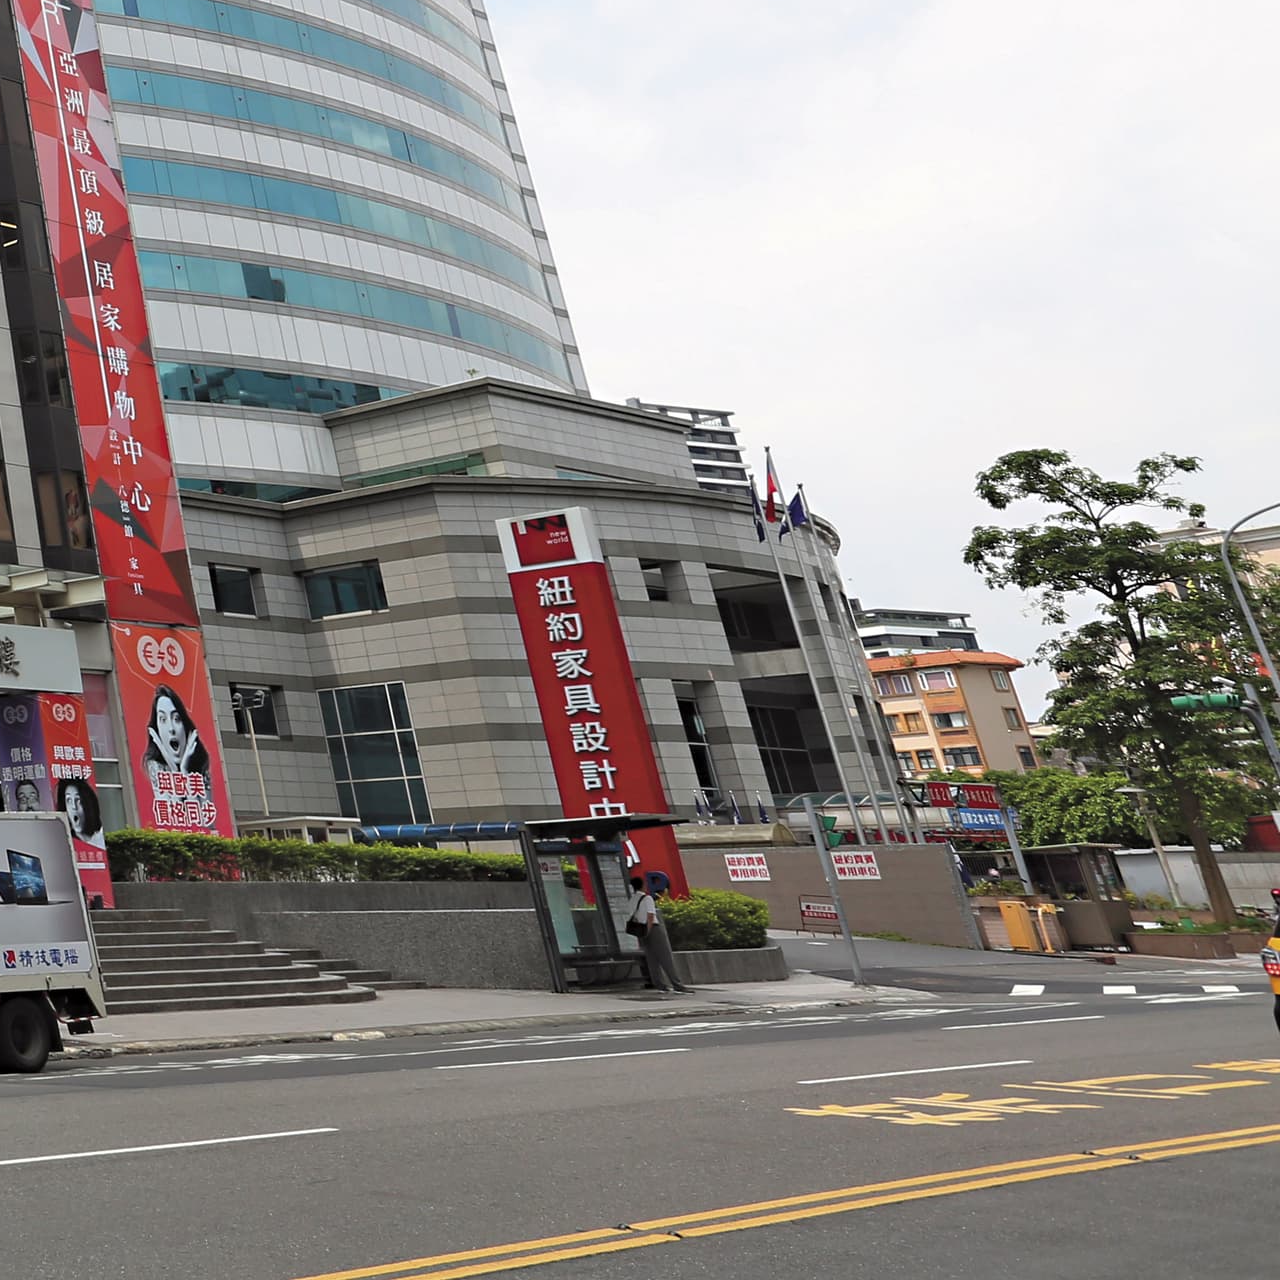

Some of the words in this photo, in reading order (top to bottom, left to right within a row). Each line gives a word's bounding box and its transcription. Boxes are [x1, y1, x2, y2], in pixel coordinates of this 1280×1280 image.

[57, 50, 107, 238] 亞洲最頂級
[93, 259, 151, 513] 居家購物中心
[546, 535, 570, 546] world
[549, 530, 567, 539] new
[10, 747, 33, 762] 價格
[53, 745, 86, 761] 與歐美
[1, 763, 46, 781] 透明運動
[51, 763, 92, 781] 價格同步
[157, 771, 207, 798] 與歐美
[153, 800, 217, 827] 價格同步
[19, 948, 80, 968] 精技電腦
